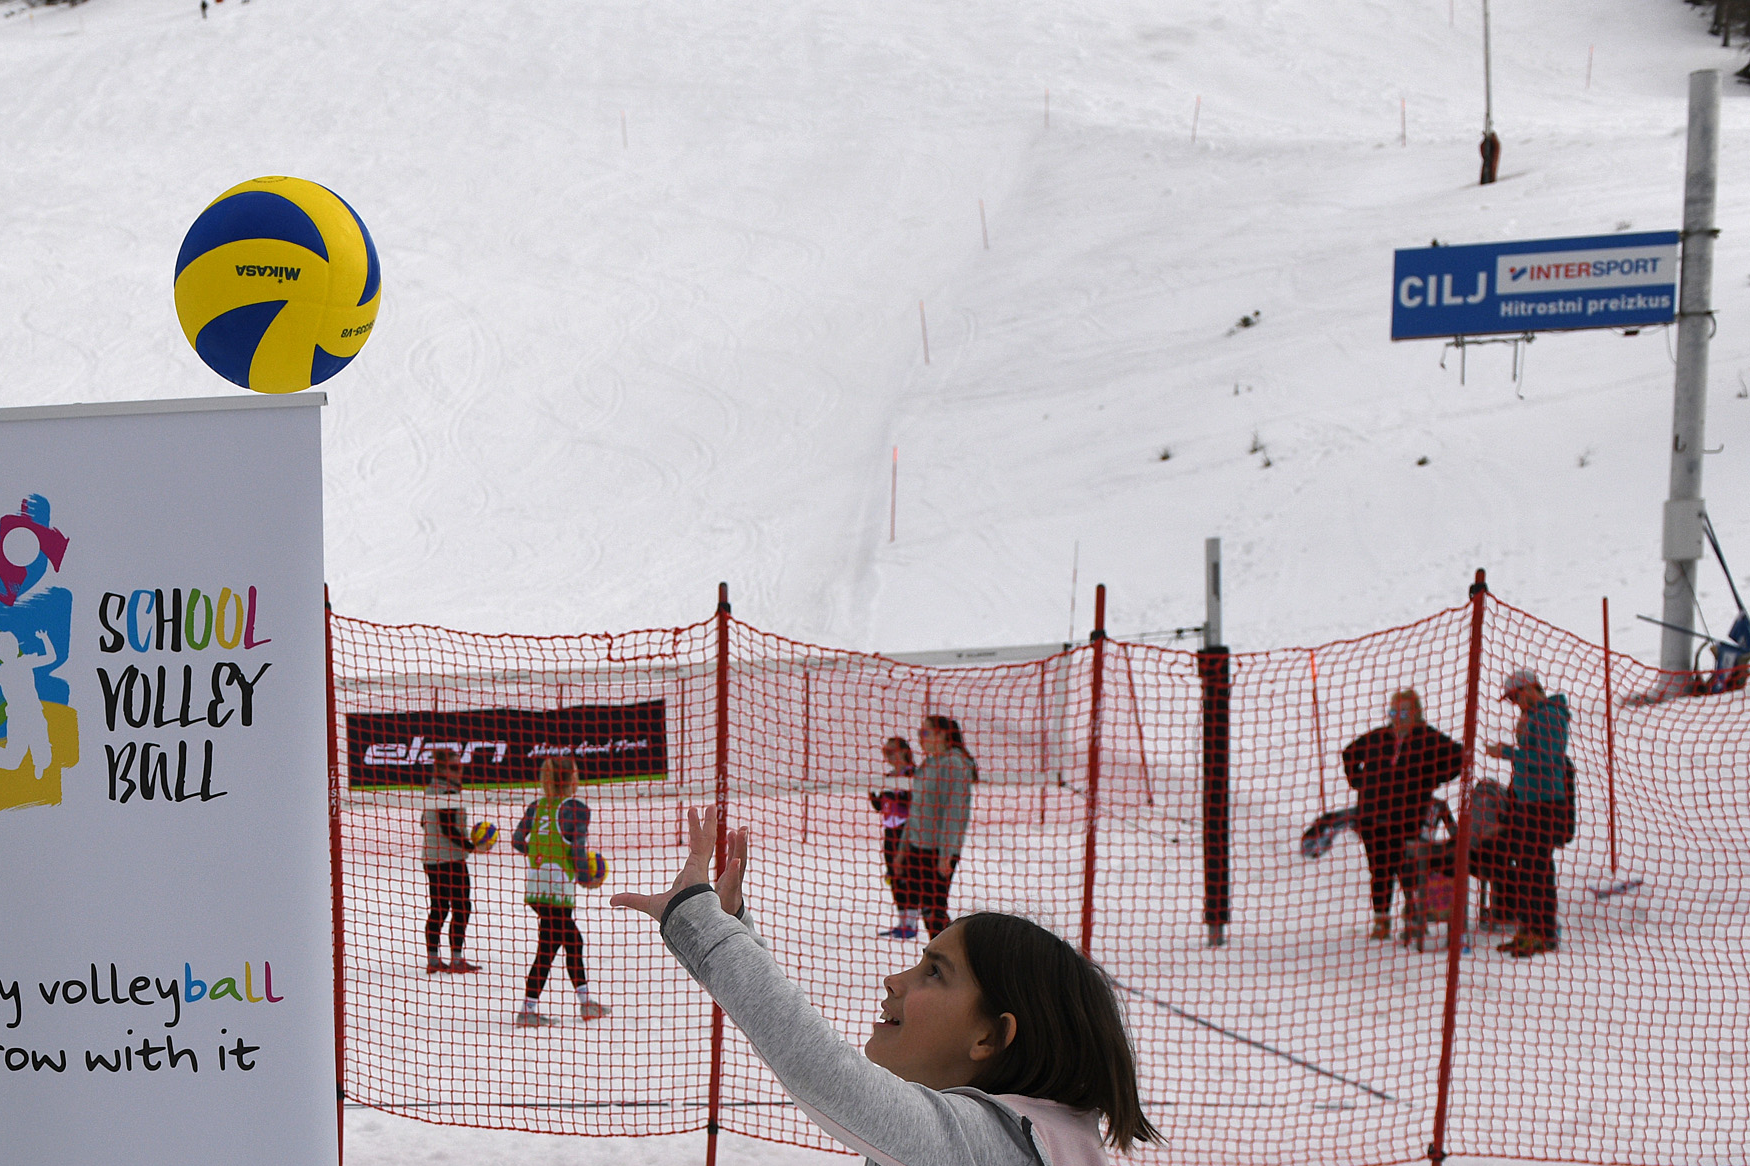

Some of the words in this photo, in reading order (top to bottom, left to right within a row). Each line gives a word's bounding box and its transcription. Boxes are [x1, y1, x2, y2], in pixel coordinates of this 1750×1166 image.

[1399, 270, 1488, 309] CILJ
[1529, 257, 1662, 281] INTERSPORT
[1500, 296, 1583, 318] Hitrostni
[1587, 293, 1671, 316] preizkus
[98, 585, 272, 653] SCHOOL
[96, 661, 273, 732] VOLLEY
[104, 739, 228, 804] BALL
[363, 735, 508, 766] elan
[330, 769, 338, 816] LISKI
[538, 815, 551, 835] 2
[38, 961, 285, 1028] volleyball
[85, 1029, 199, 1073] with
[218, 1028, 261, 1072] it
